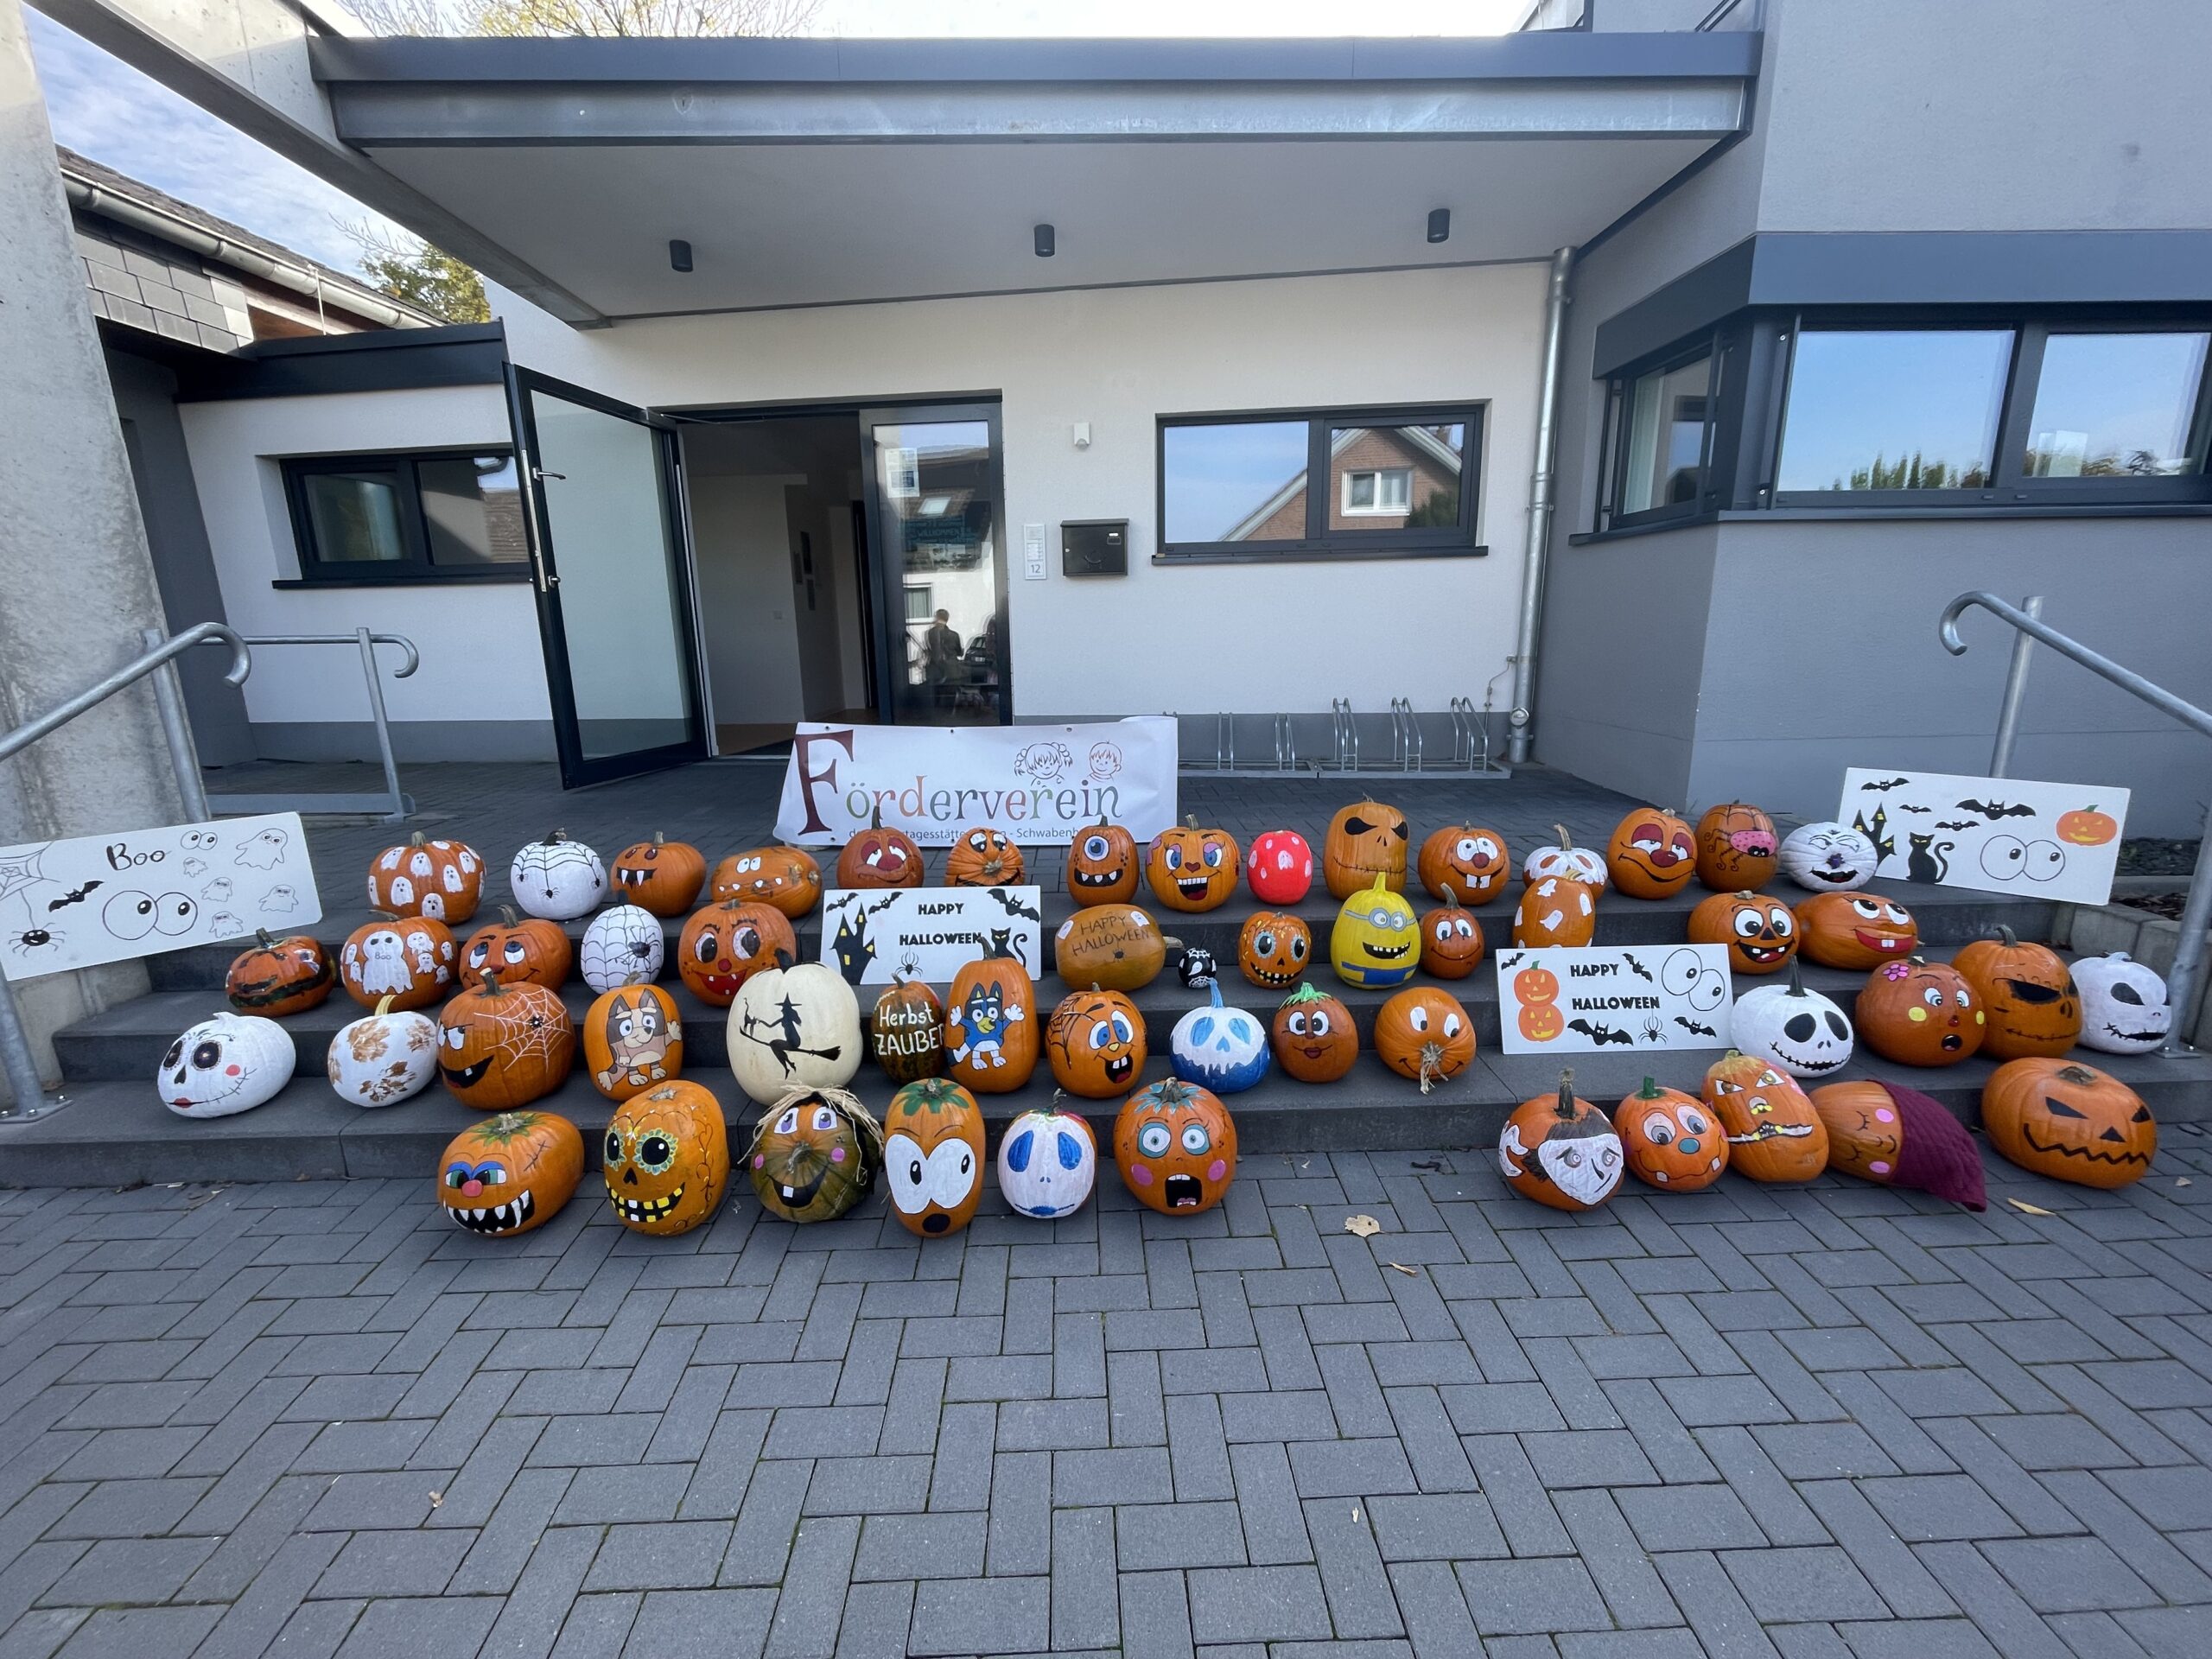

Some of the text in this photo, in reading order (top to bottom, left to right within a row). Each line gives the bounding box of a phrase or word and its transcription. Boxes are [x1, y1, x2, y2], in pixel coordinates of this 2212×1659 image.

[1031, 563, 1041, 574] 12
[794, 729, 1122, 836] Förderverein
[904, 830, 965, 841] tagesstätte
[1016, 827, 1078, 838] Schwabenh
[106, 842, 166, 871] Boo
[918, 903, 964, 915] HAPPY
[1080, 916, 1126, 935] HAPPY
[899, 932, 982, 945] HALLOWEEN
[1071, 929, 1149, 957] HALLOWEEN
[375, 951, 391, 960] Boo
[1570, 963, 1618, 976] HAPPY
[1573, 996, 1660, 1010] HALLOWEEN
[880, 1001, 934, 1027] Herbst
